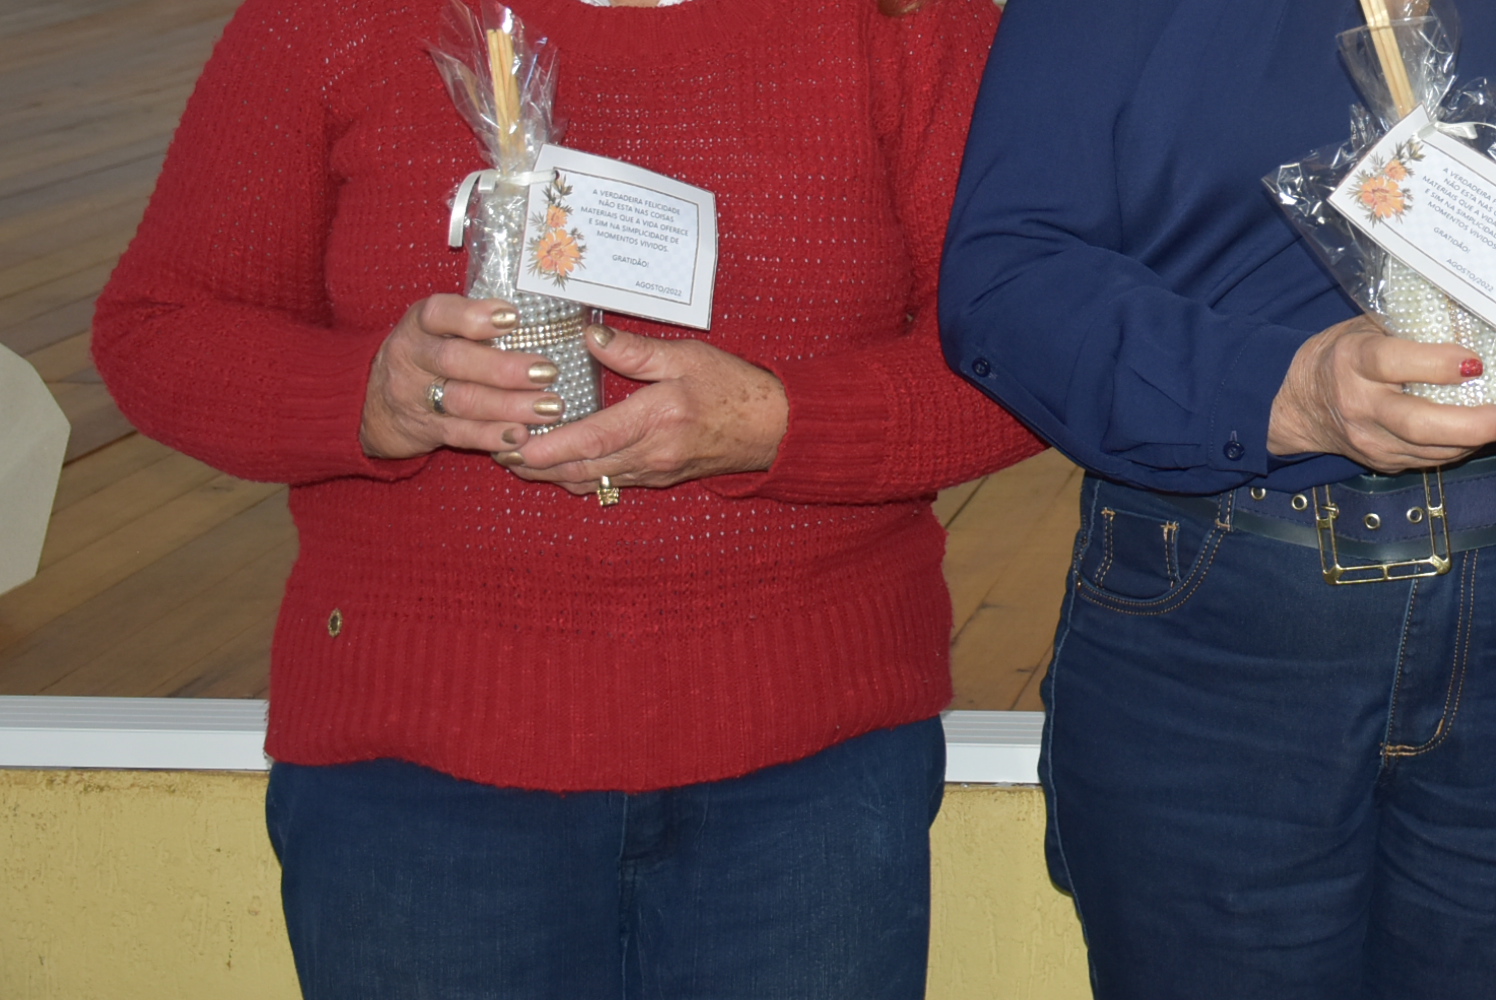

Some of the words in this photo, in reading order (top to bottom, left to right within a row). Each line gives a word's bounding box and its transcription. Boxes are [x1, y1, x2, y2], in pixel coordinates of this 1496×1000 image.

[1423, 176, 1458, 201] MATERIAIS
[1459, 199, 1473, 211] QUE
[1431, 192, 1444, 203] SIM
[1444, 178, 1460, 191] NÃO
[1478, 200, 1493, 212] NAS
[1450, 171, 1492, 201] VERDADEIRA
[600, 190, 643, 204] VERDADEIRA
[645, 201, 680, 215] FELICIDADE
[635, 208, 648, 216] NAS
[651, 212, 674, 222] COISAS
[581, 206, 617, 219] MATERIAIS
[620, 215, 633, 223] QUE
[643, 220, 658, 228] VIDA
[660, 224, 688, 236] OFERECE
[1428, 202, 1468, 231] MOMENTOS
[595, 219, 608, 227] SIM
[622, 226, 668, 242] SIMPLICIDADE
[597, 230, 638, 245] MOMENTOS
